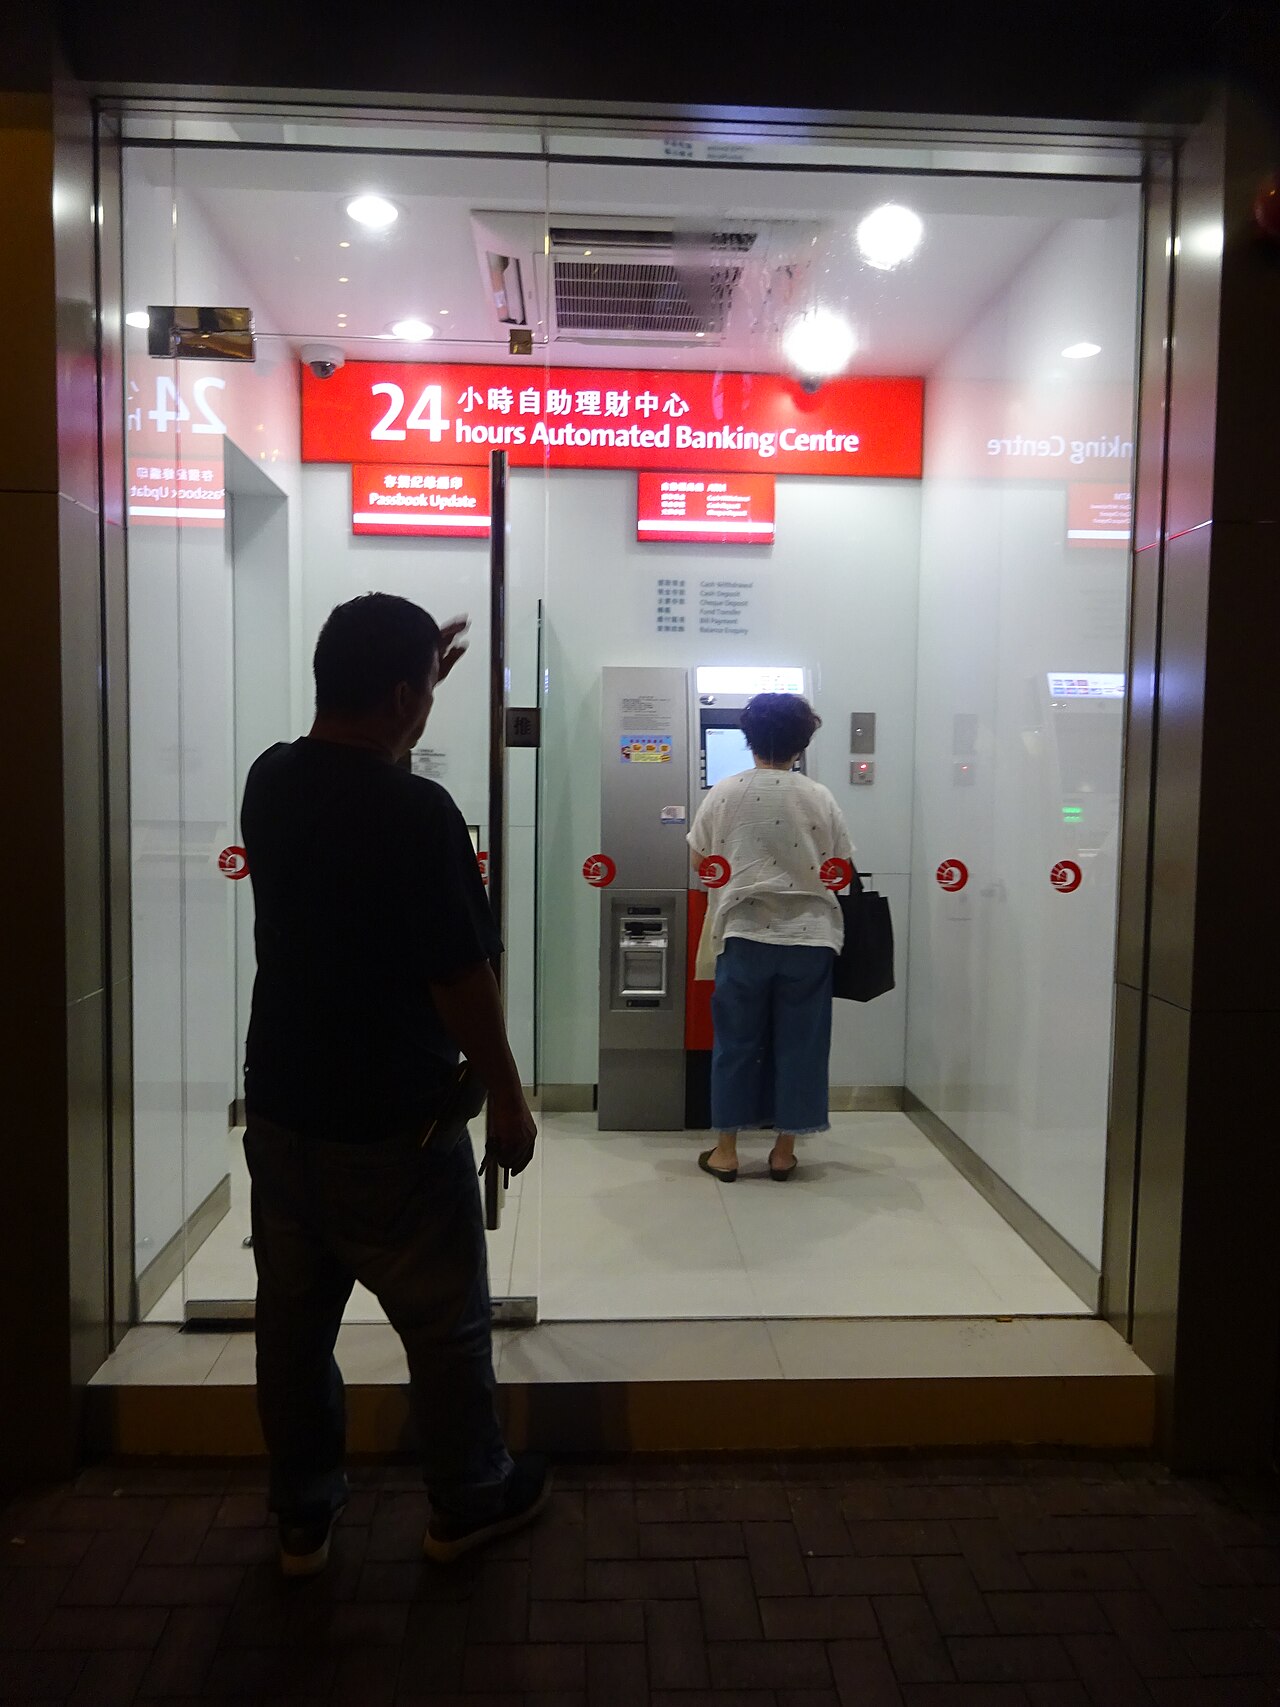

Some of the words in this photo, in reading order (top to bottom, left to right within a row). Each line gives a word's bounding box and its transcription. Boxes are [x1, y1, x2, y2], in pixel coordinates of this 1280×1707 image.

[457, 386, 690, 418] 小時自助理財中心
[370, 382, 450, 443] 24
[455, 418, 525, 443] hours
[530, 421, 670, 448] Automated
[676, 425, 776, 457] Banking
[779, 428, 859, 452] Centre
[369, 492, 429, 507] Passbook
[429, 494, 476, 510] Update
